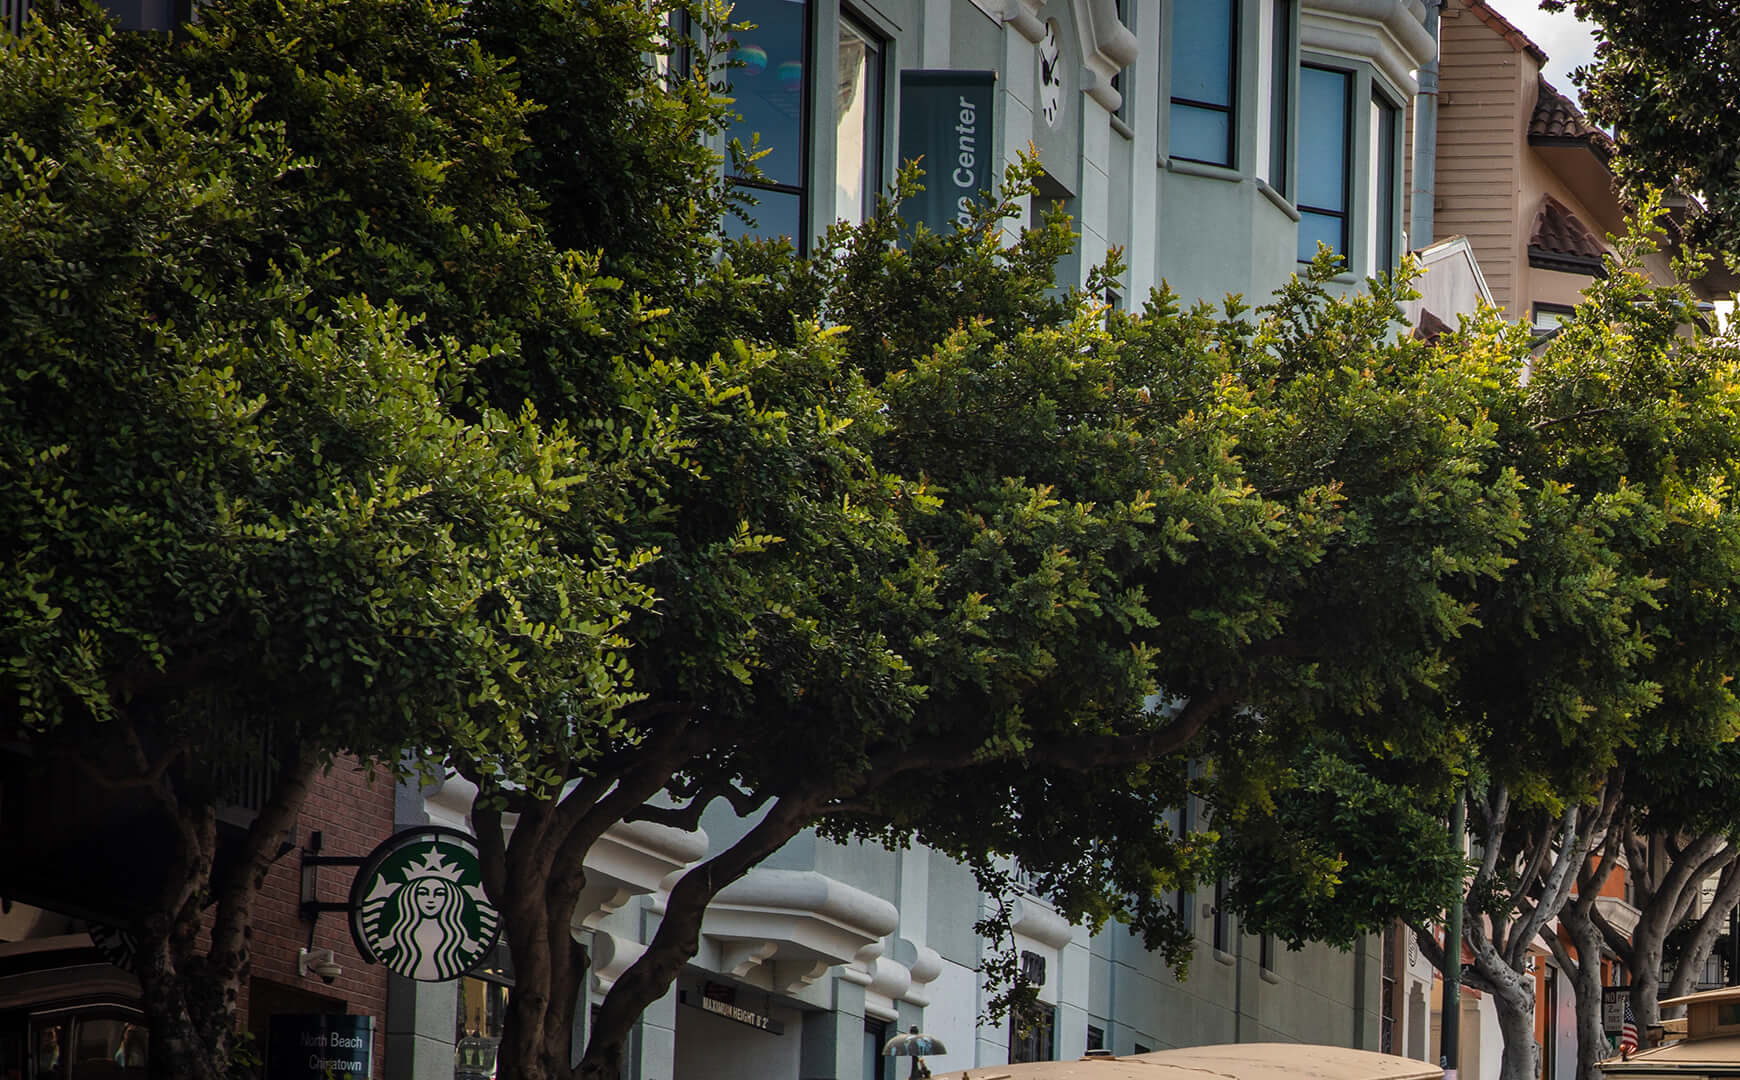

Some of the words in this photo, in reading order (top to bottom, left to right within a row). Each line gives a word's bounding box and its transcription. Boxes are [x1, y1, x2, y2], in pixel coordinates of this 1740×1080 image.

[952, 95, 976, 188] Center
[733, 1007, 755, 1026] HEIGHT
[300, 1032, 328, 1048] North
[330, 1032, 363, 1049] Beach
[308, 1054, 362, 1071] Chinatown
